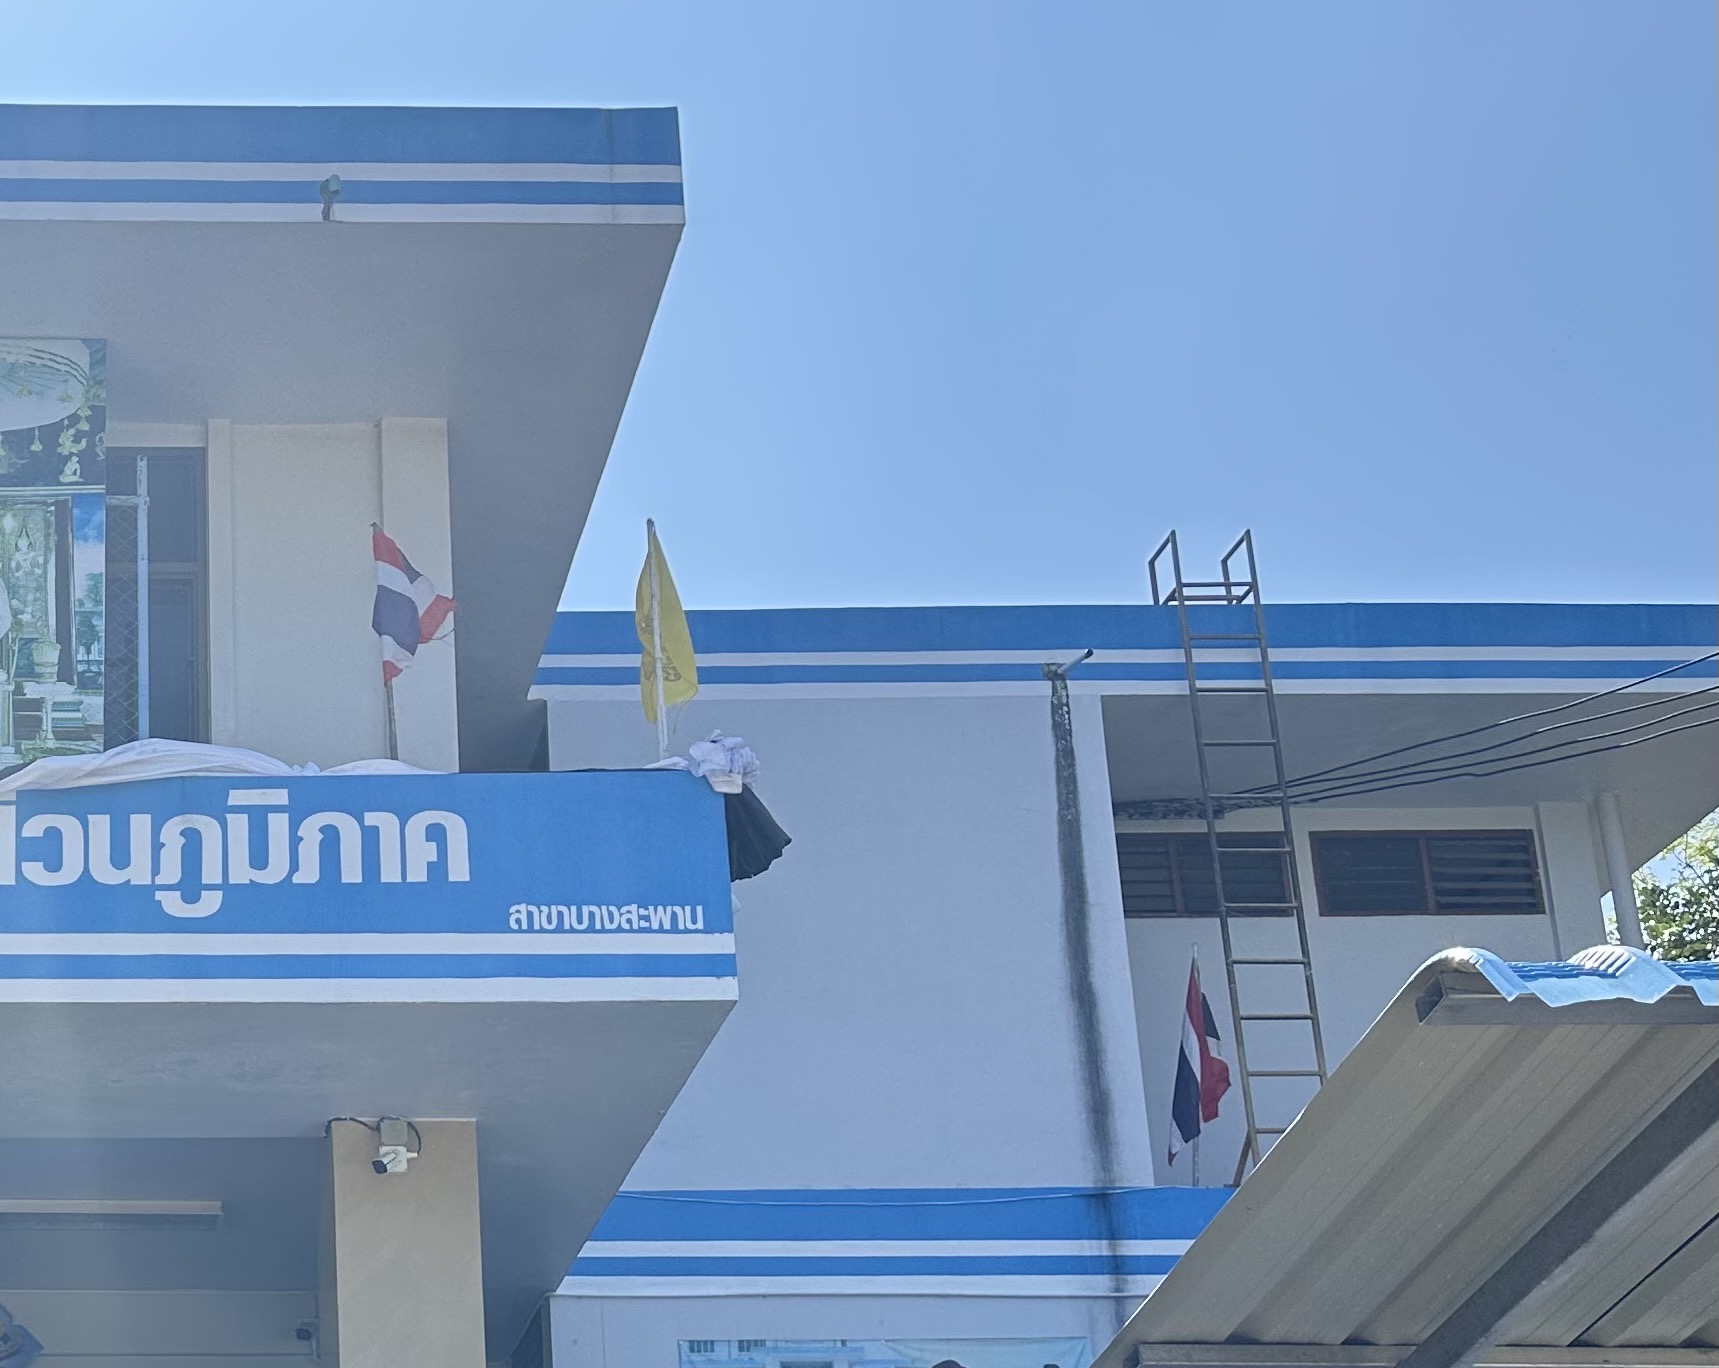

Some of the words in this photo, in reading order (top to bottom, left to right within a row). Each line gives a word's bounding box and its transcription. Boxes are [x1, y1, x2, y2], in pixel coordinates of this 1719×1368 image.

[508, 902, 704, 931] สาขาบางสะพาน
